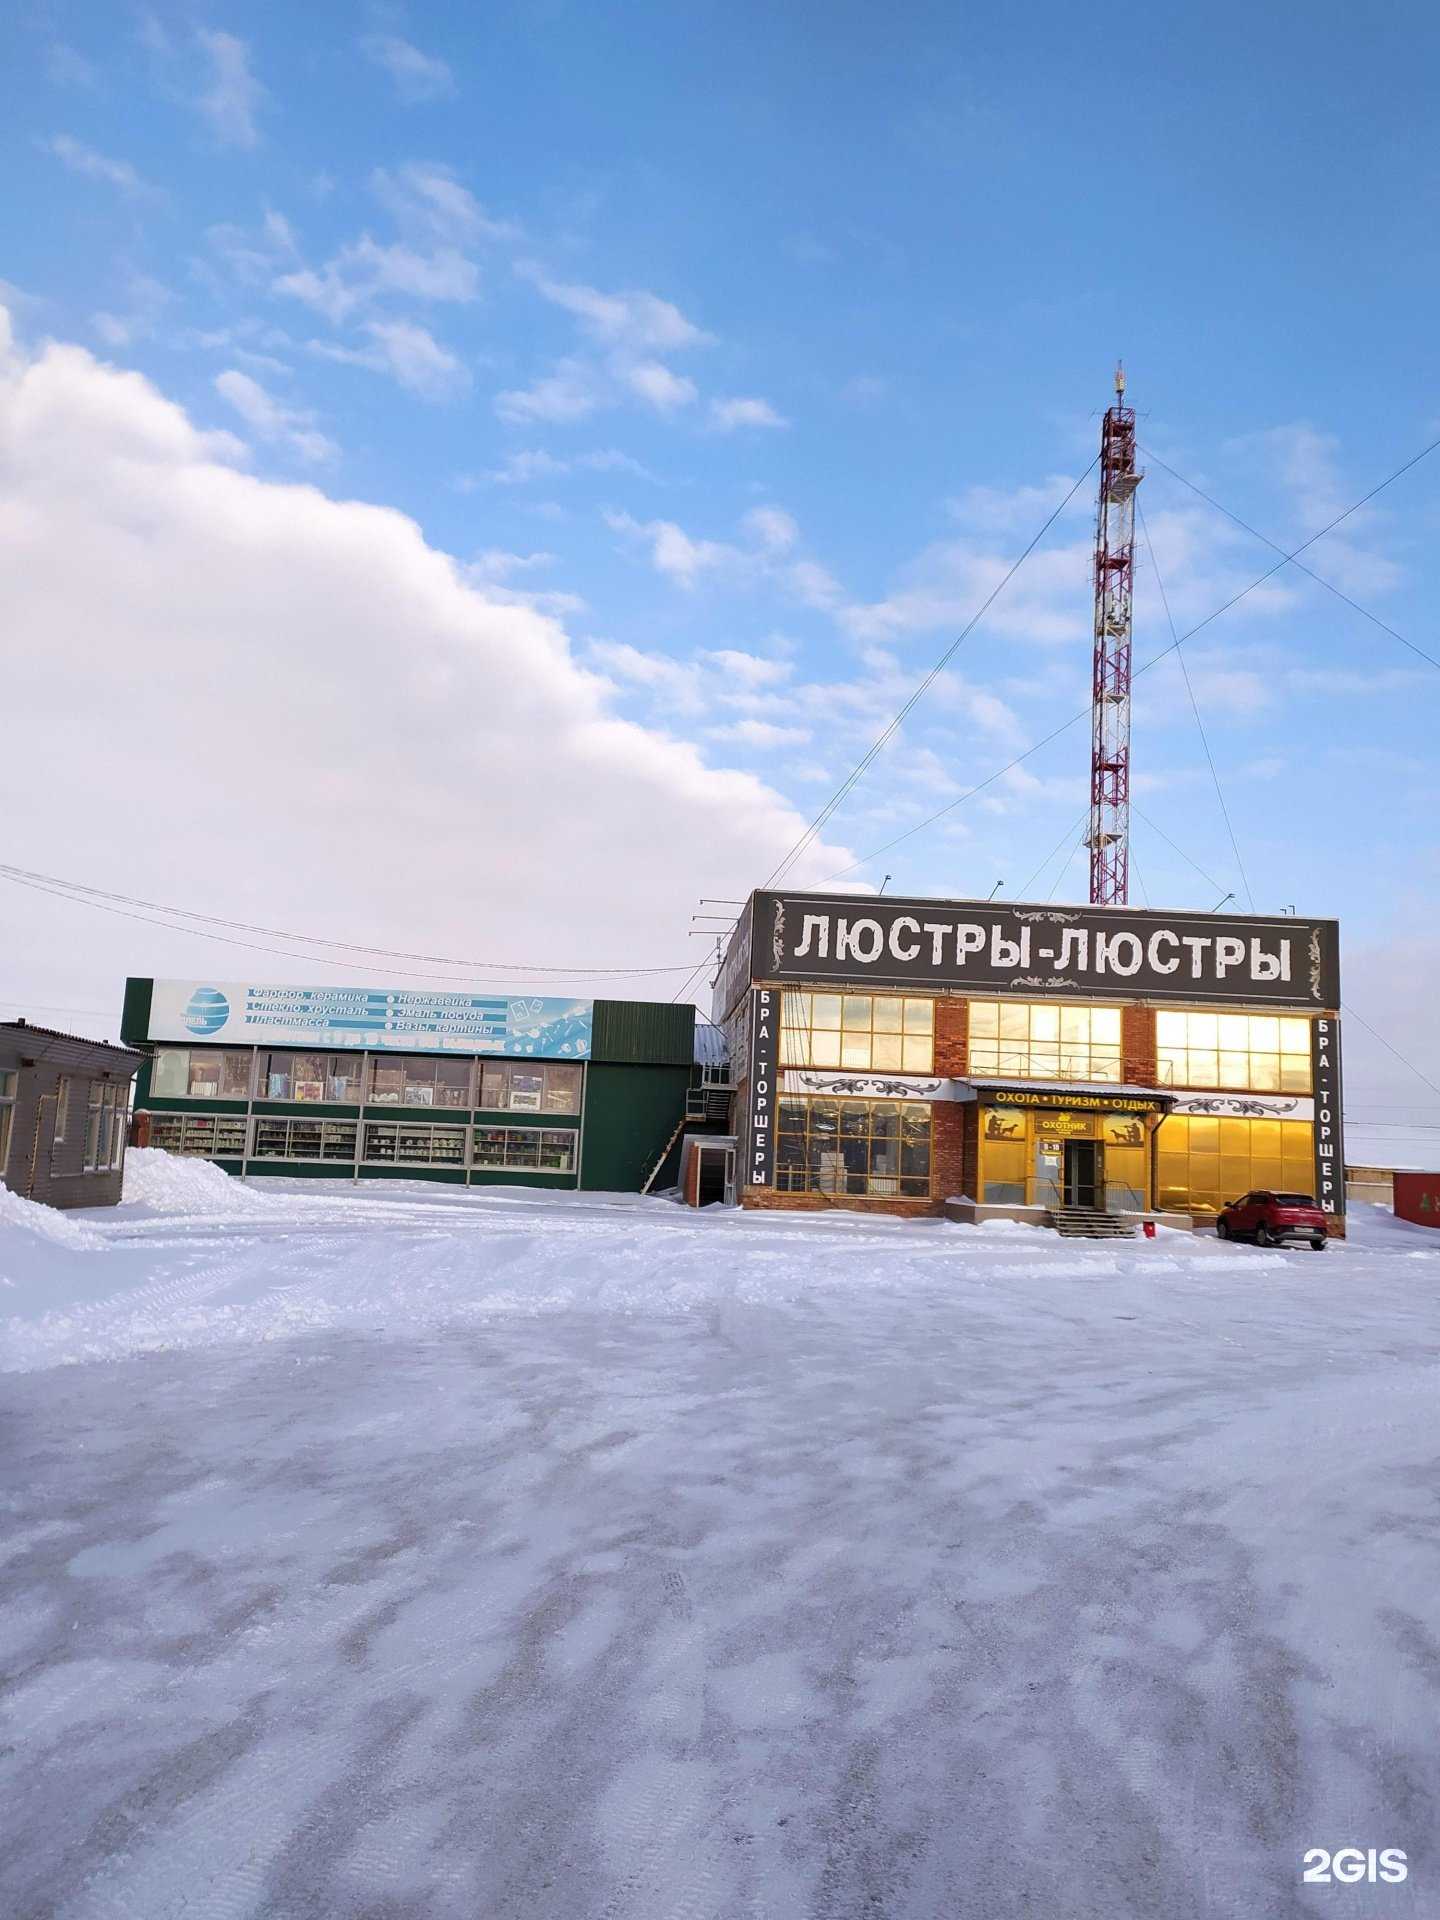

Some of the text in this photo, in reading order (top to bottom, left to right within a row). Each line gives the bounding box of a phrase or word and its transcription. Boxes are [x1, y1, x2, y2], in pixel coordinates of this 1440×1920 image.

[793, 913, 1292, 982] ЛЮСТРЫ-ЛЮСТРЫ
[310, 991, 369, 1003] керамика
[308, 1004, 369, 1016] хрусталь
[397, 1005, 437, 1018] Эмаль
[250, 1014, 329, 1027] Пластмасса
[436, 1023, 494, 1036] картины
[995, 1092, 1156, 1111] ОХОТА ТУРИЗМ ОТДЫХ
[1042, 1120, 1087, 1131] ОХОТНИК
